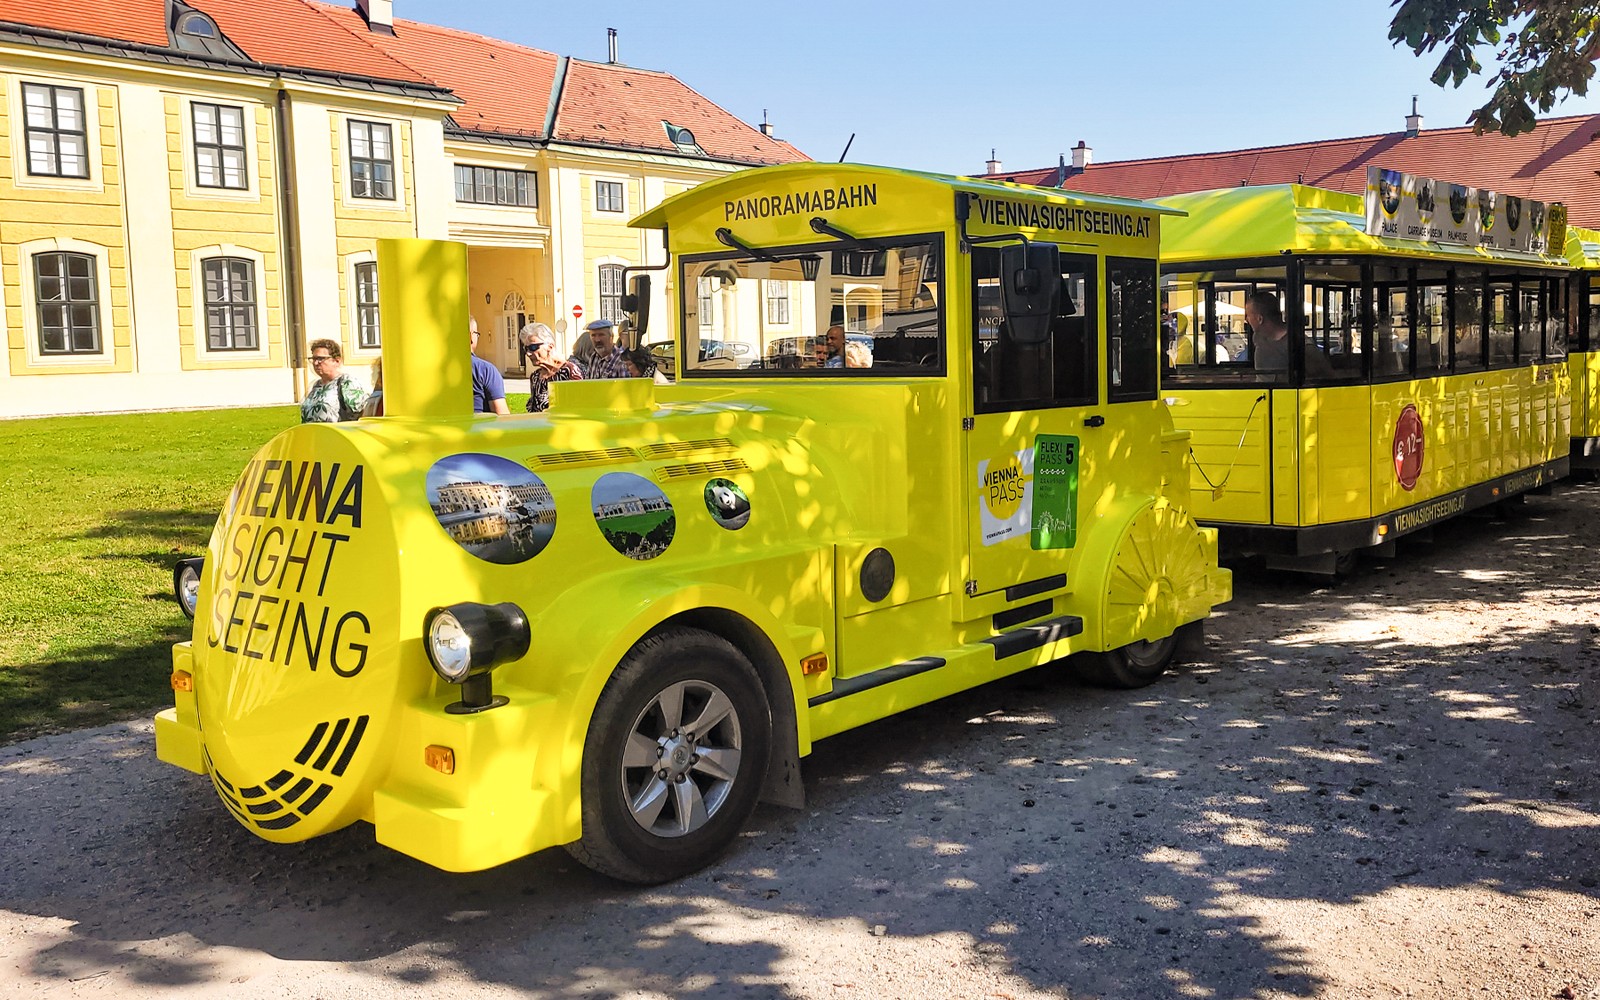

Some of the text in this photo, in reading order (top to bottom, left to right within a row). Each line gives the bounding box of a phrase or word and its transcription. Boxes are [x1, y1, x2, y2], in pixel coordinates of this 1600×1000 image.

[725, 183, 878, 222] PANORAMABAHN
[978, 198, 1151, 239] VIENNASIGHTSEEING.AT
[1382, 222, 1398, 234] PALACE
[1040, 453, 1062, 465] PASS
[1041, 441, 1075, 465] FLEXI 5
[229, 459, 364, 529] VIENNA
[983, 465, 1019, 487] VIENNA
[990, 477, 1025, 507] PASS
[1395, 494, 1466, 532] VIENNASIGHTSEEING.AT
[224, 522, 350, 597] SIGHT
[207, 588, 371, 678] SEEING
